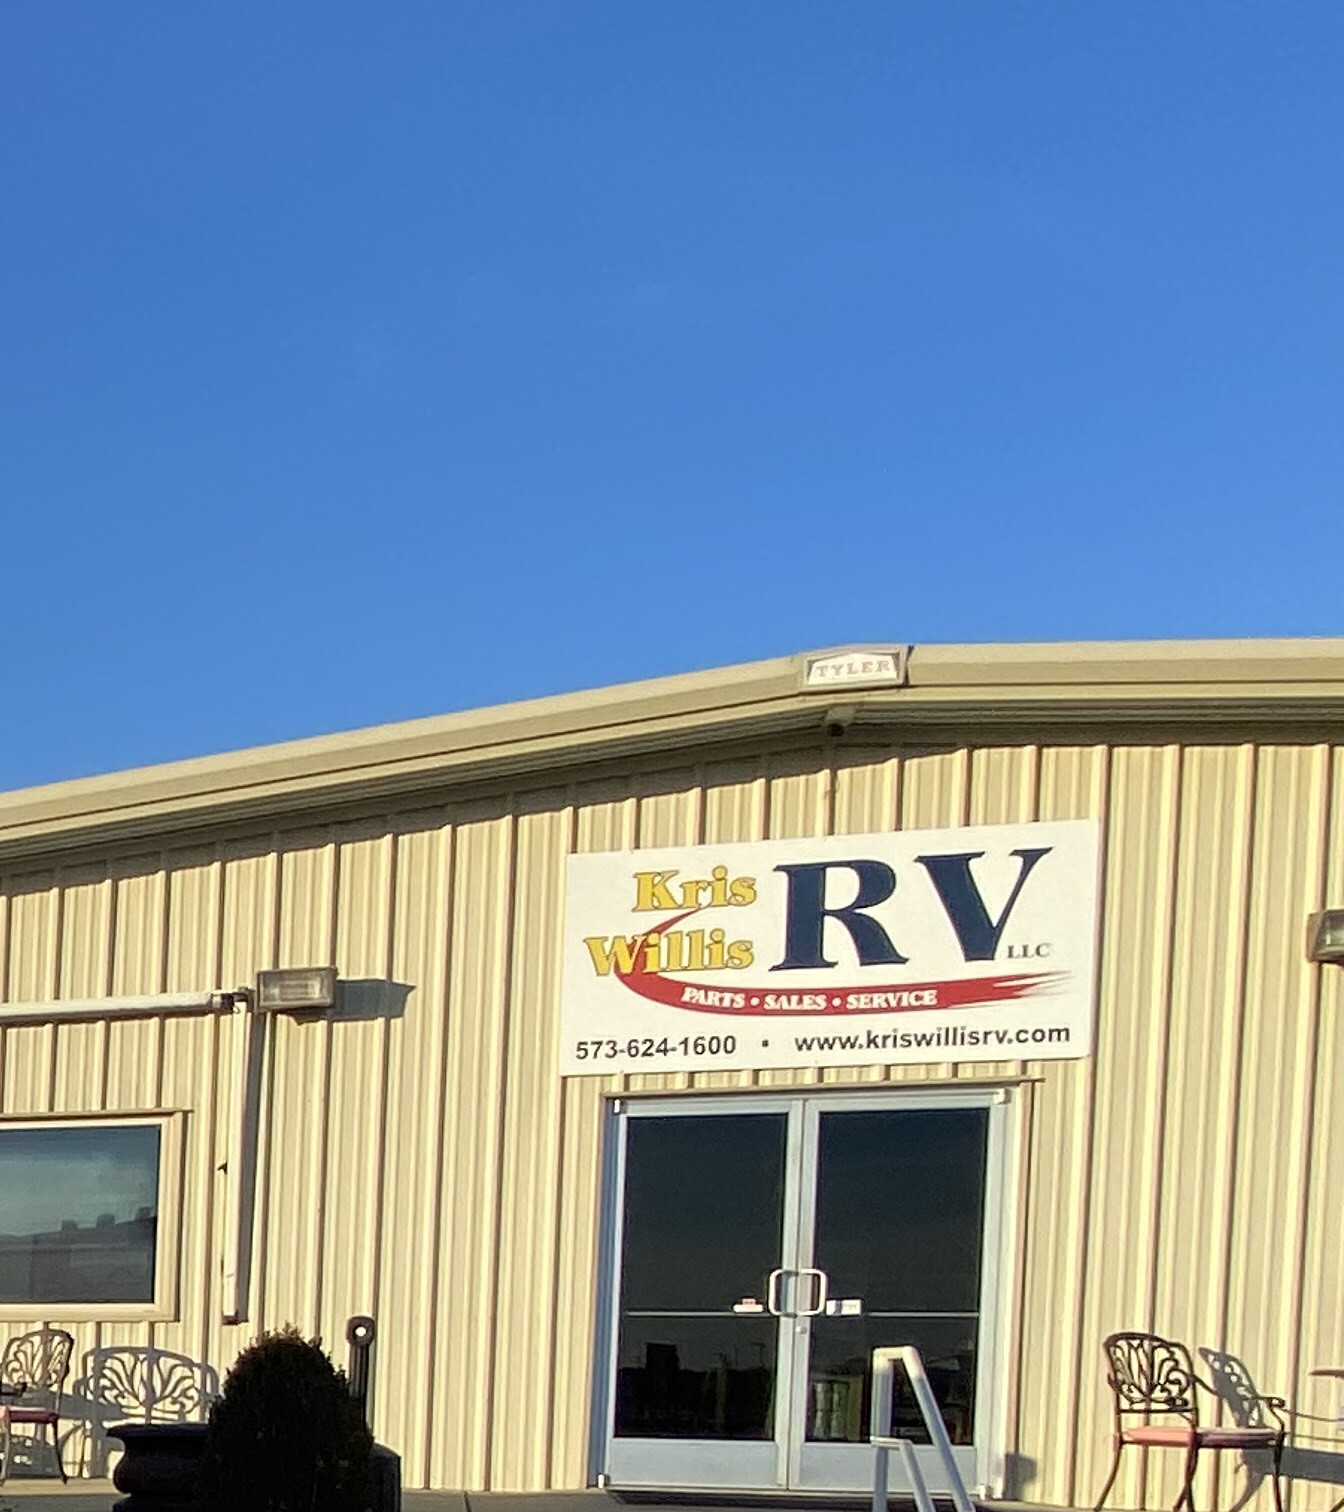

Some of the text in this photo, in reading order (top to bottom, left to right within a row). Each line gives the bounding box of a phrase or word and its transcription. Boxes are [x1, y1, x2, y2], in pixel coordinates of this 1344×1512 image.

[816, 661, 891, 677] TYLER
[632, 865, 758, 912] Kris
[769, 847, 1053, 972] RV
[583, 929, 755, 977] Willis
[1006, 942, 1052, 959] LLC
[680, 987, 938, 1010] PARTS SALES SERVICE
[575, 1025, 1071, 1060] 573-624-1600 www.kriswillisrv.com
